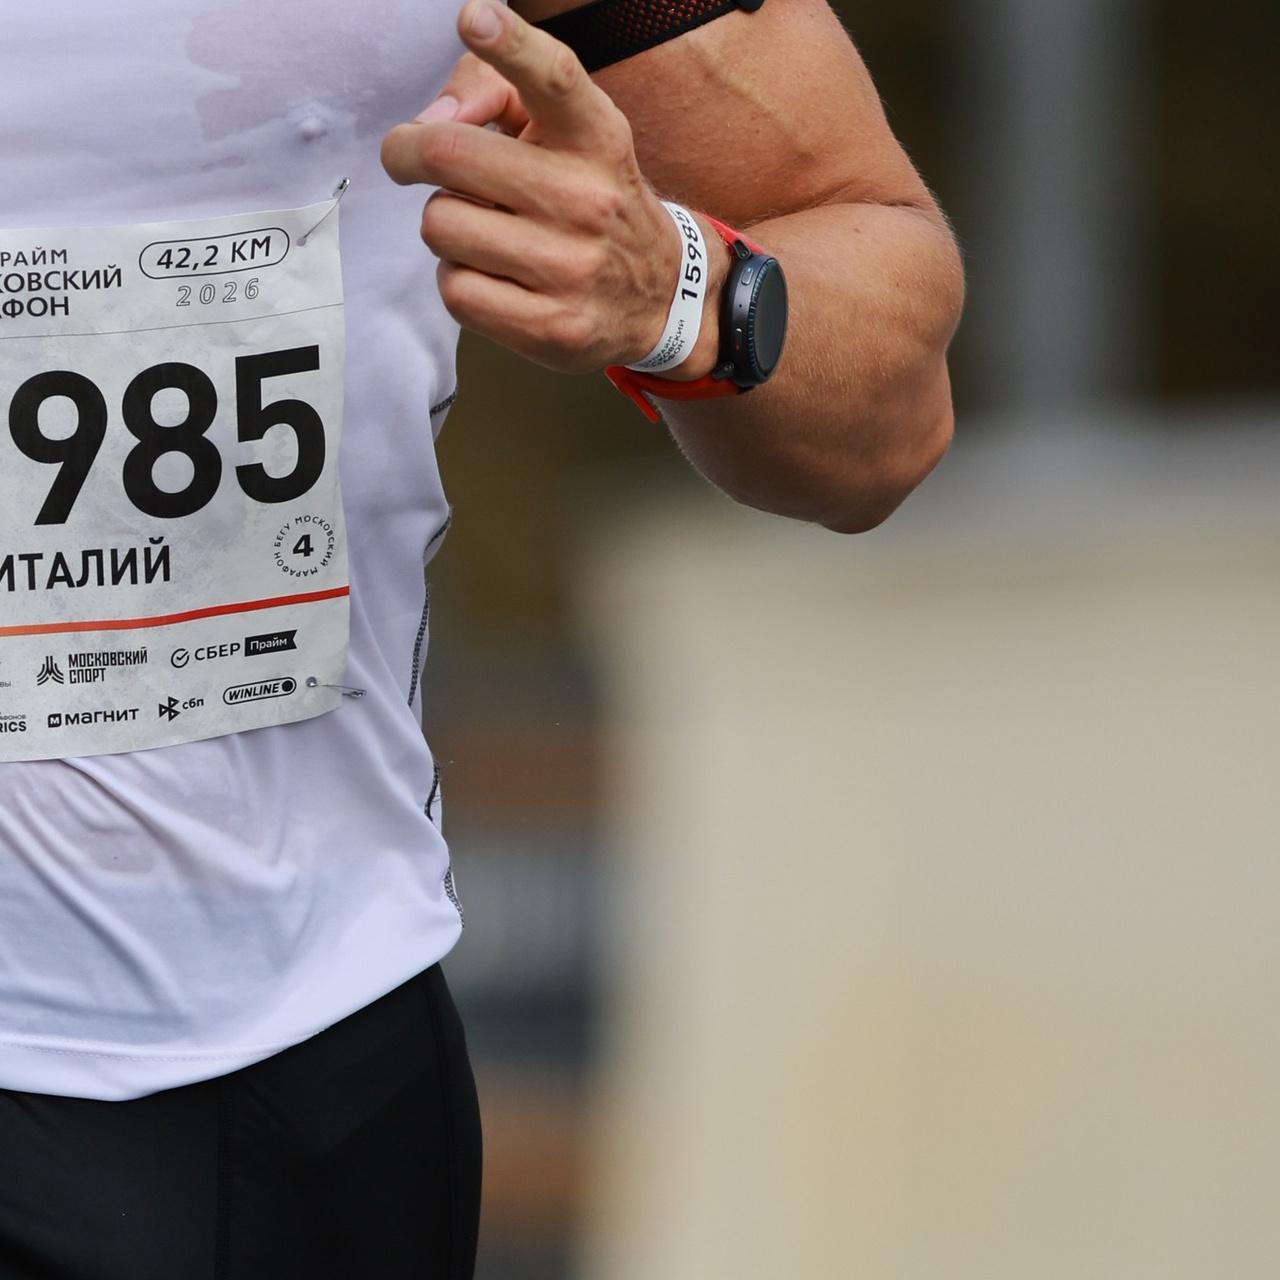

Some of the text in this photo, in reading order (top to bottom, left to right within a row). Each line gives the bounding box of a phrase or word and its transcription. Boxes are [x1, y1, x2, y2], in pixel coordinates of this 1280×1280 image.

[156, 235, 271, 271] 42,2 КМ
[672, 210, 702, 301] 15985
[176, 278, 260, 307] 2026
[274, 514, 335, 578] БЕГУ МОСКОВСКИЙ МАРАФОН
[292, 534, 315, 558] 4
[68, 646, 148, 668] МОСКОВСКИЙ
[194, 636, 288, 661] СБЕР Прайм
[69, 668, 106, 684] СПОРТ
[228, 682, 280, 701] WINLINE
[182, 698, 204, 710] сбп
[65, 708, 139, 726] магнит
